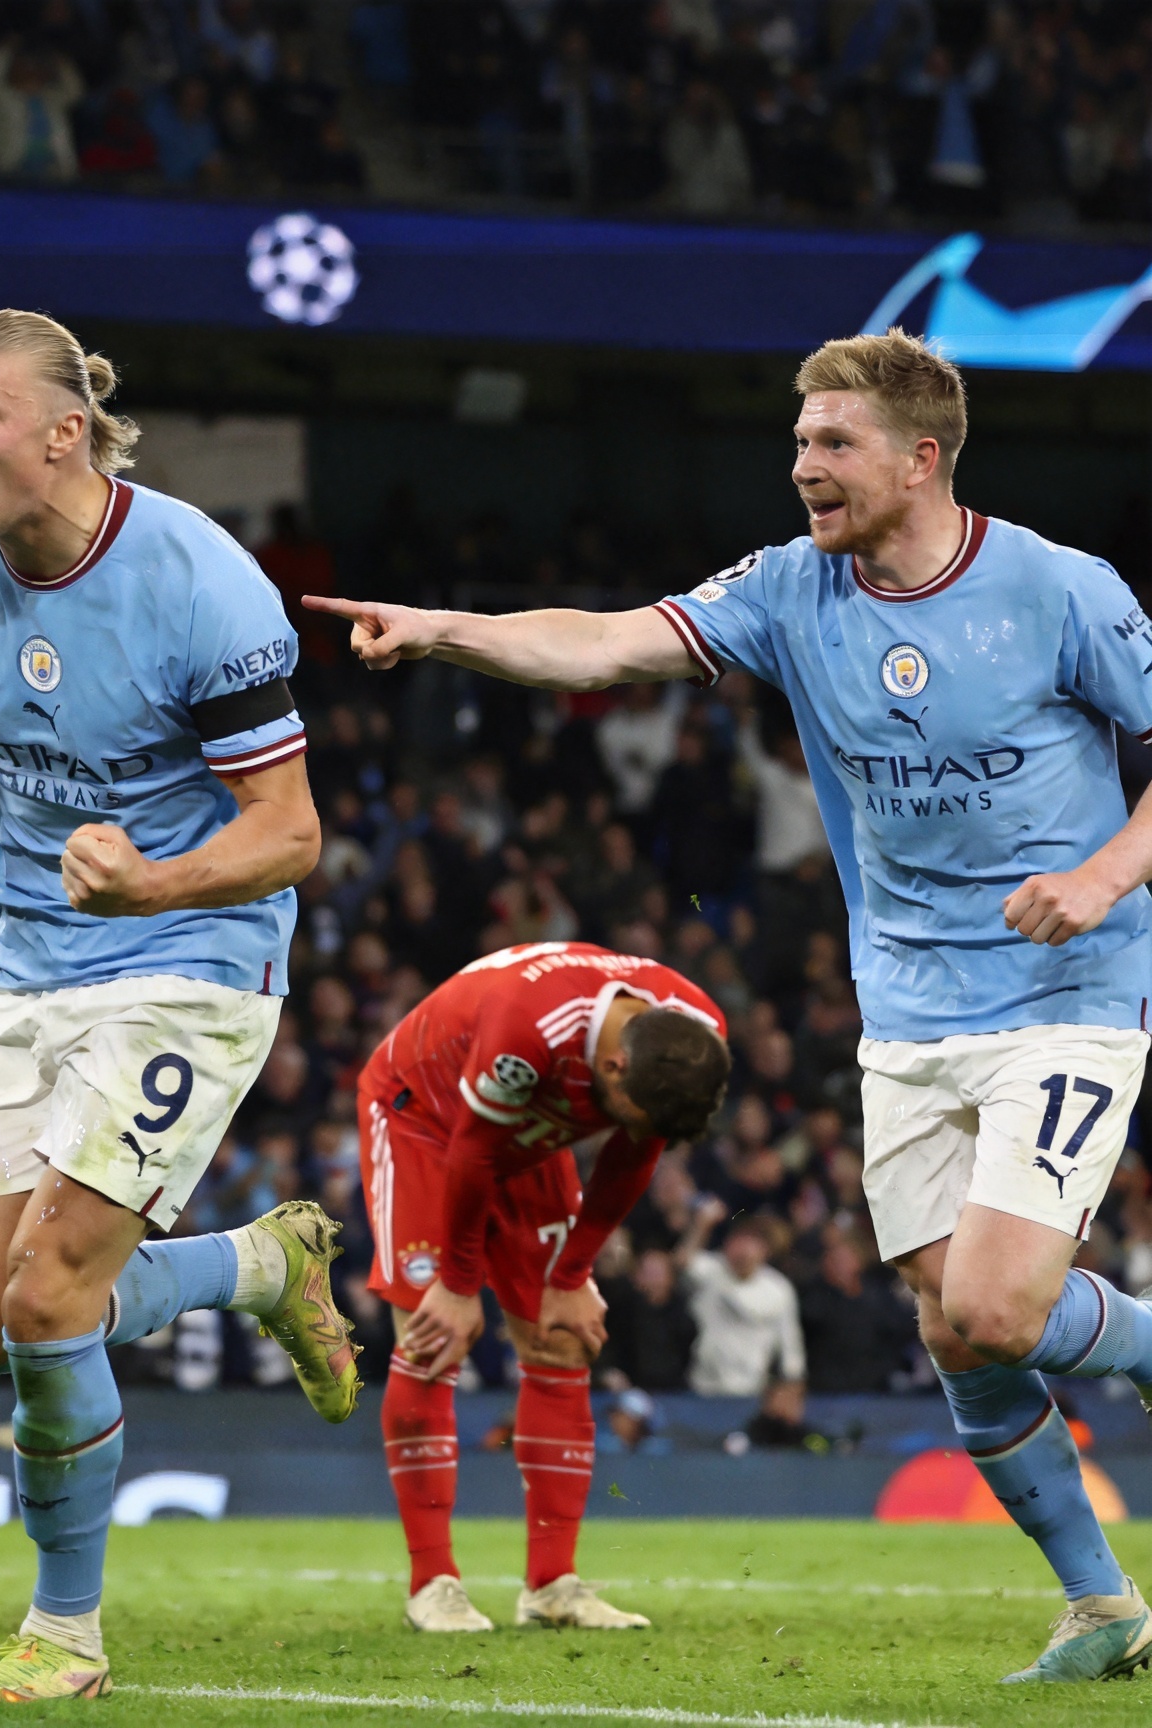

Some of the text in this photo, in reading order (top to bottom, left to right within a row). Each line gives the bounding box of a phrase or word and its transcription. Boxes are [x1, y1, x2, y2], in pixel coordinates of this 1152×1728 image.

[865, 790, 992, 819] AIRWAYS
[133, 1052, 194, 1134] 9
[1035, 1073, 1113, 1159] 17
[537, 1221, 569, 1284] 7
